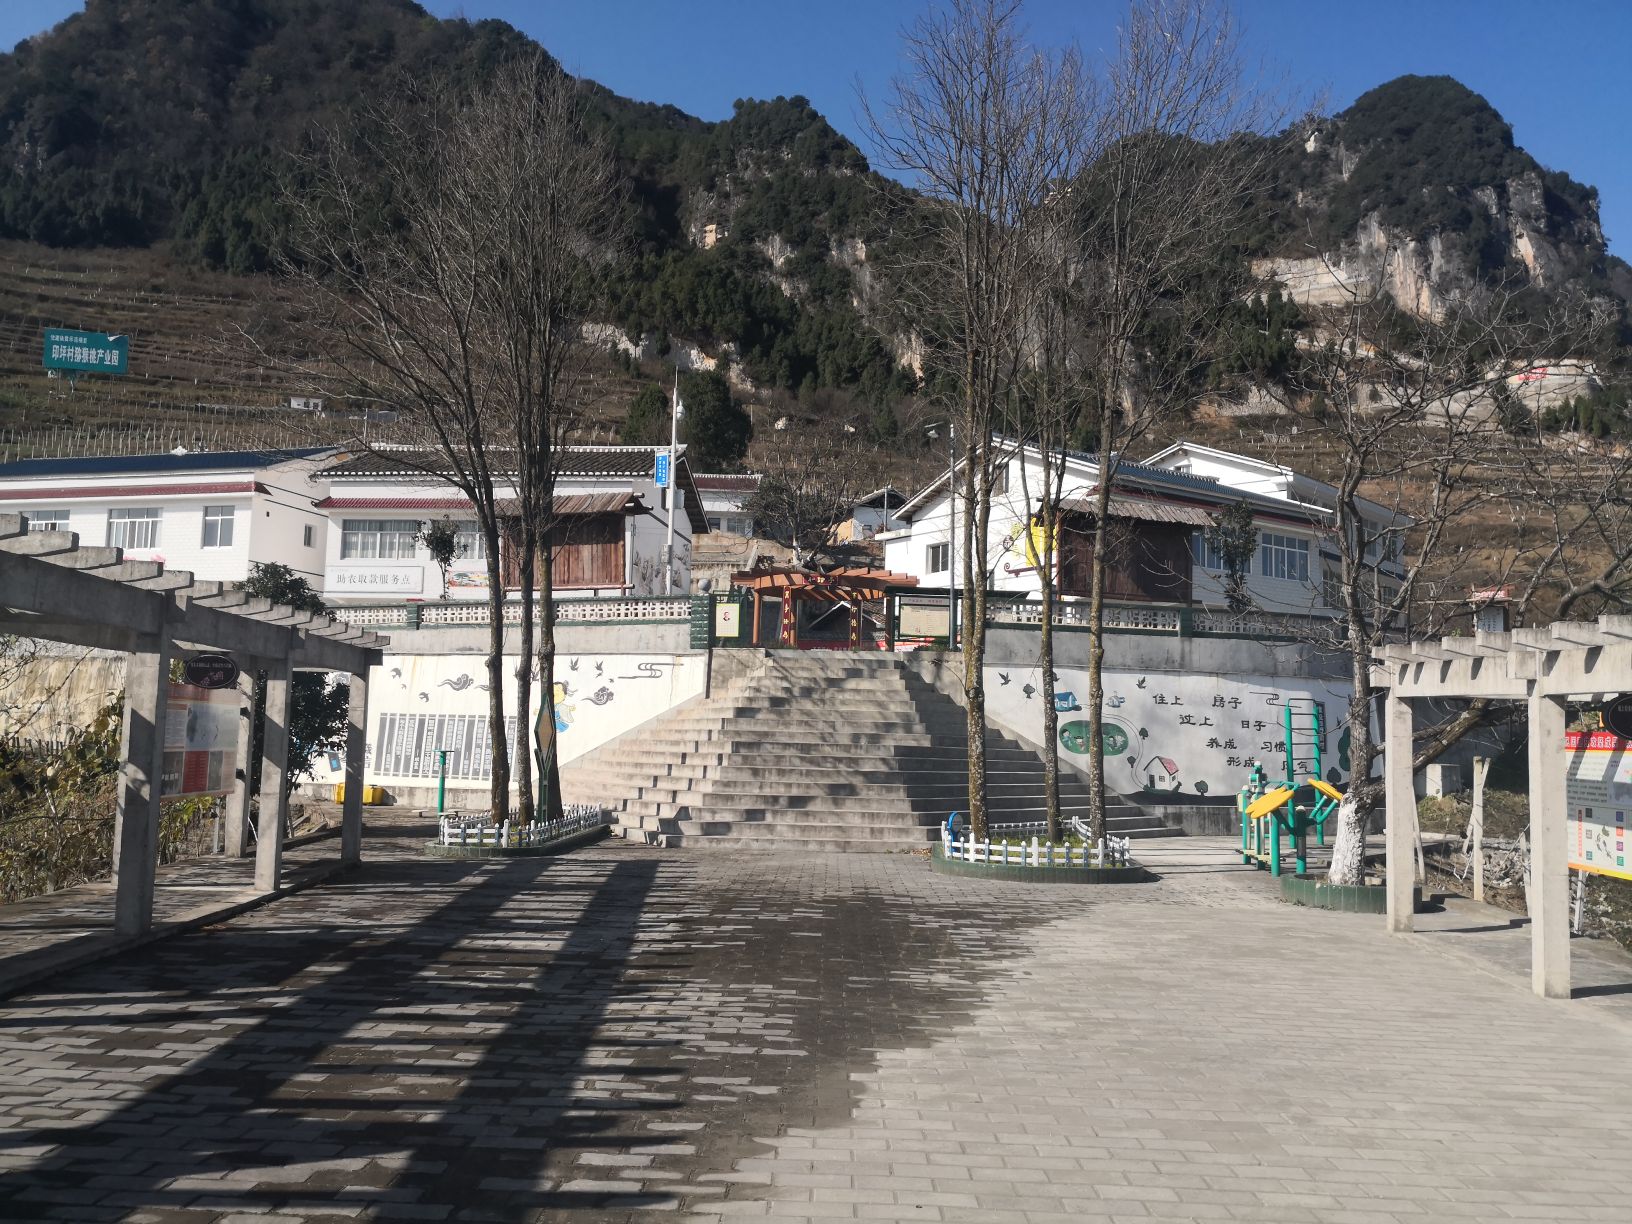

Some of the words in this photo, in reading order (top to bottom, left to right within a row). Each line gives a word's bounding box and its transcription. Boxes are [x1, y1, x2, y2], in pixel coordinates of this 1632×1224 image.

[336, 573, 411, 585] 助农取款服务点
[1152, 693, 1184, 706] 住上
[1211, 694, 1242, 709] 房子
[1179, 714, 1214, 727] 过上
[1240, 720, 1267, 732] 日子
[1206, 737, 1237, 750] 养成
[1261, 741, 1287, 753] 习惯
[1226, 756, 1255, 768] 形成
